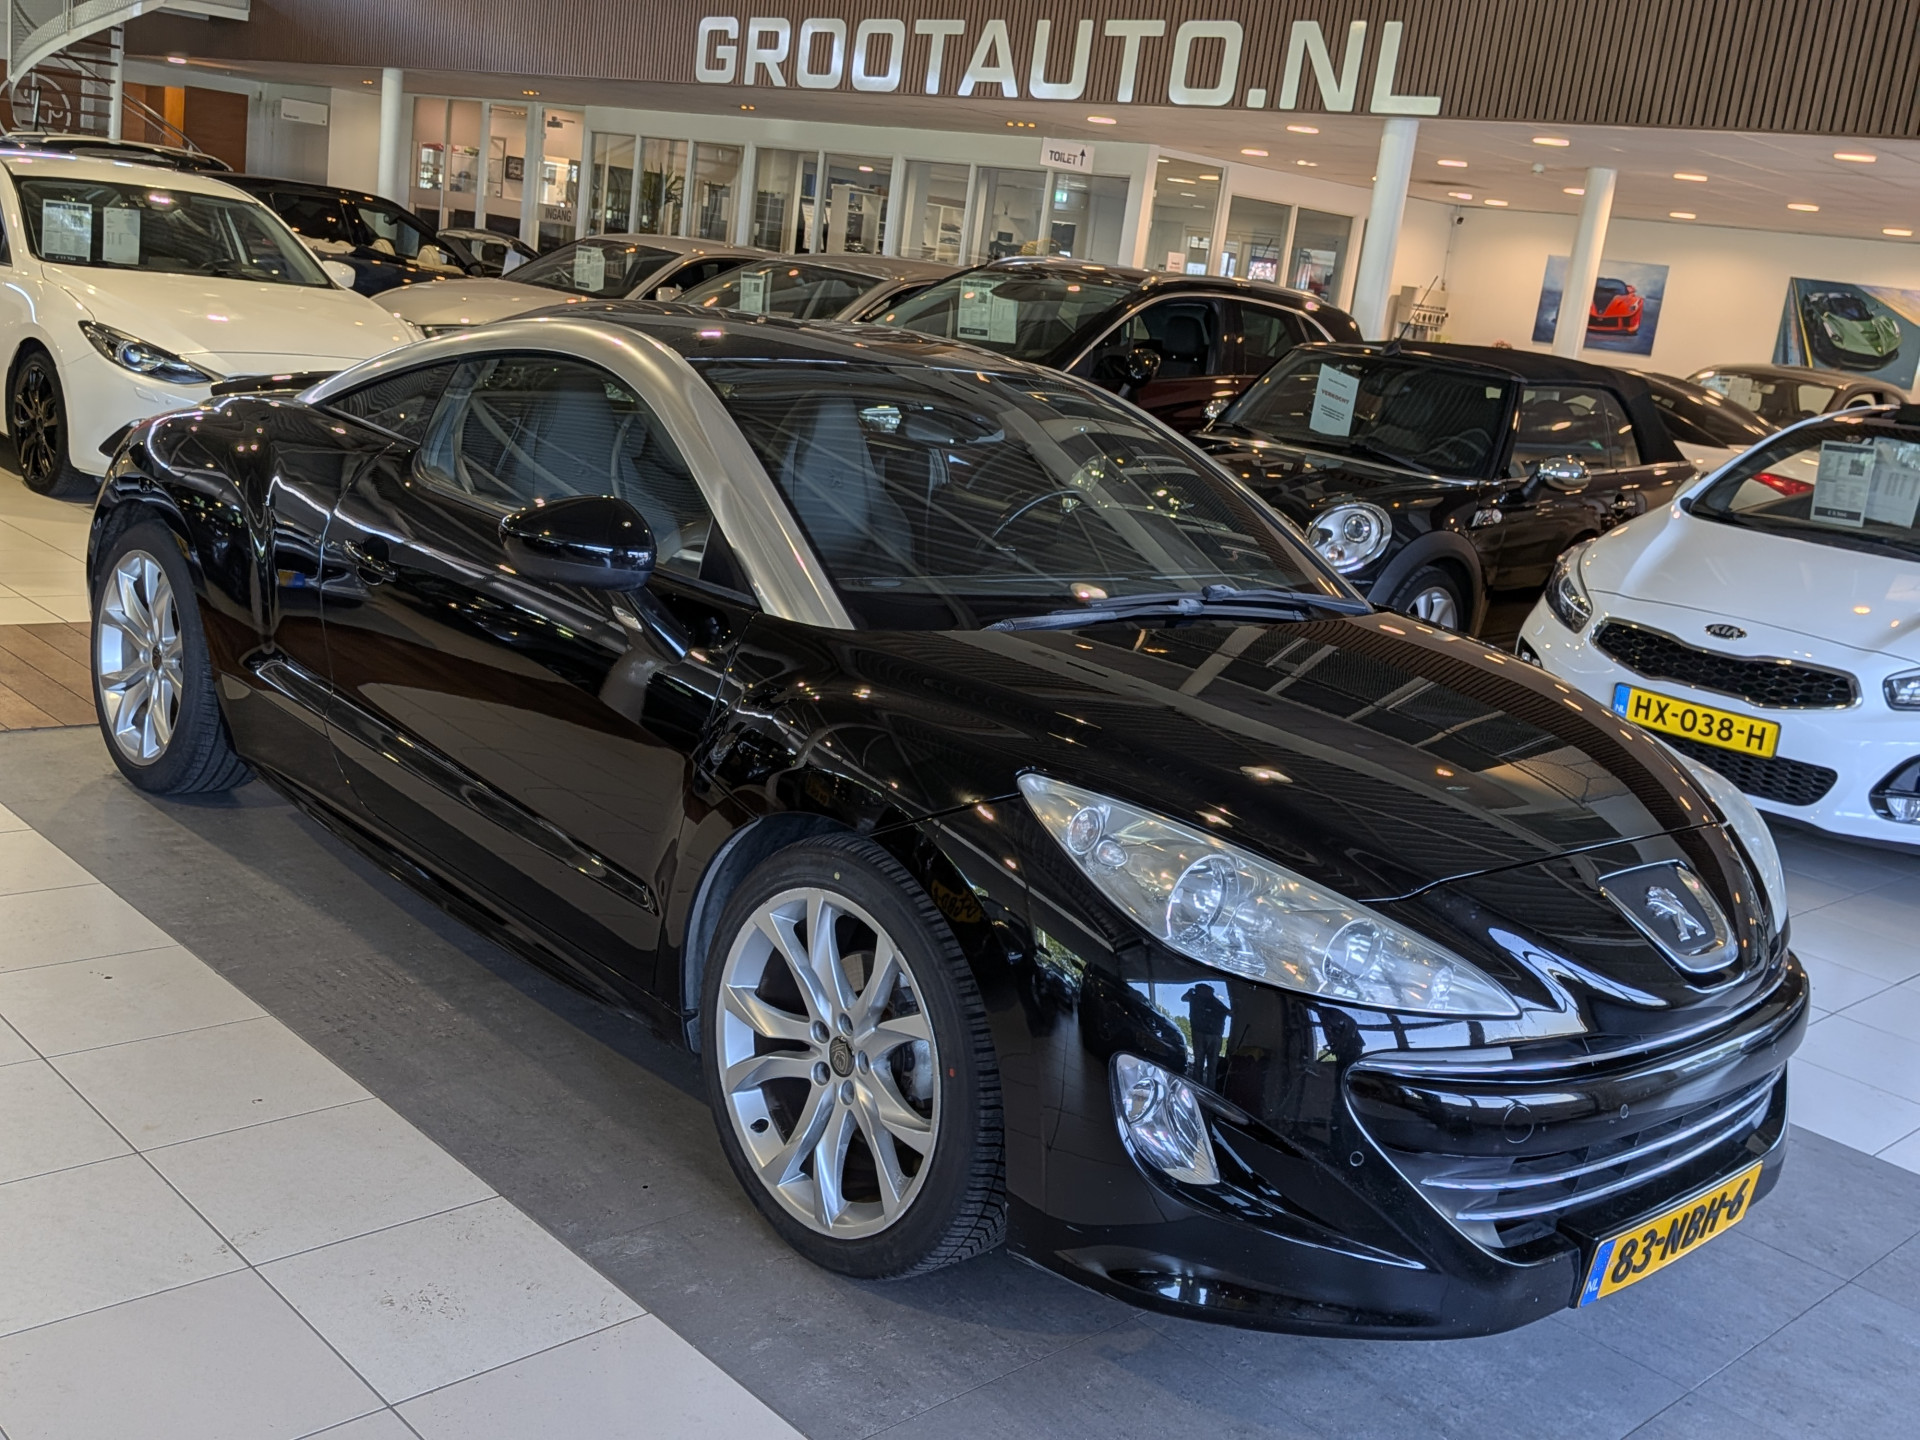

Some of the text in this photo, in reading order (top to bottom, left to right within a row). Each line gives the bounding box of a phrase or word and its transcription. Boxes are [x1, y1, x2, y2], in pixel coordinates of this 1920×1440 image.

[695, 16, 1442, 116] GROOTAUTO.NL
[1049, 150, 1078, 165] TOILET
[545, 207, 571, 222] INGANG
[1709, 623, 1740, 638] KIA
[1614, 703, 1625, 714] NL
[1633, 695, 1767, 751] HX-038-H
[1610, 1178, 1751, 1284] 83-NBH-6
[1586, 1279, 1598, 1293] NL
